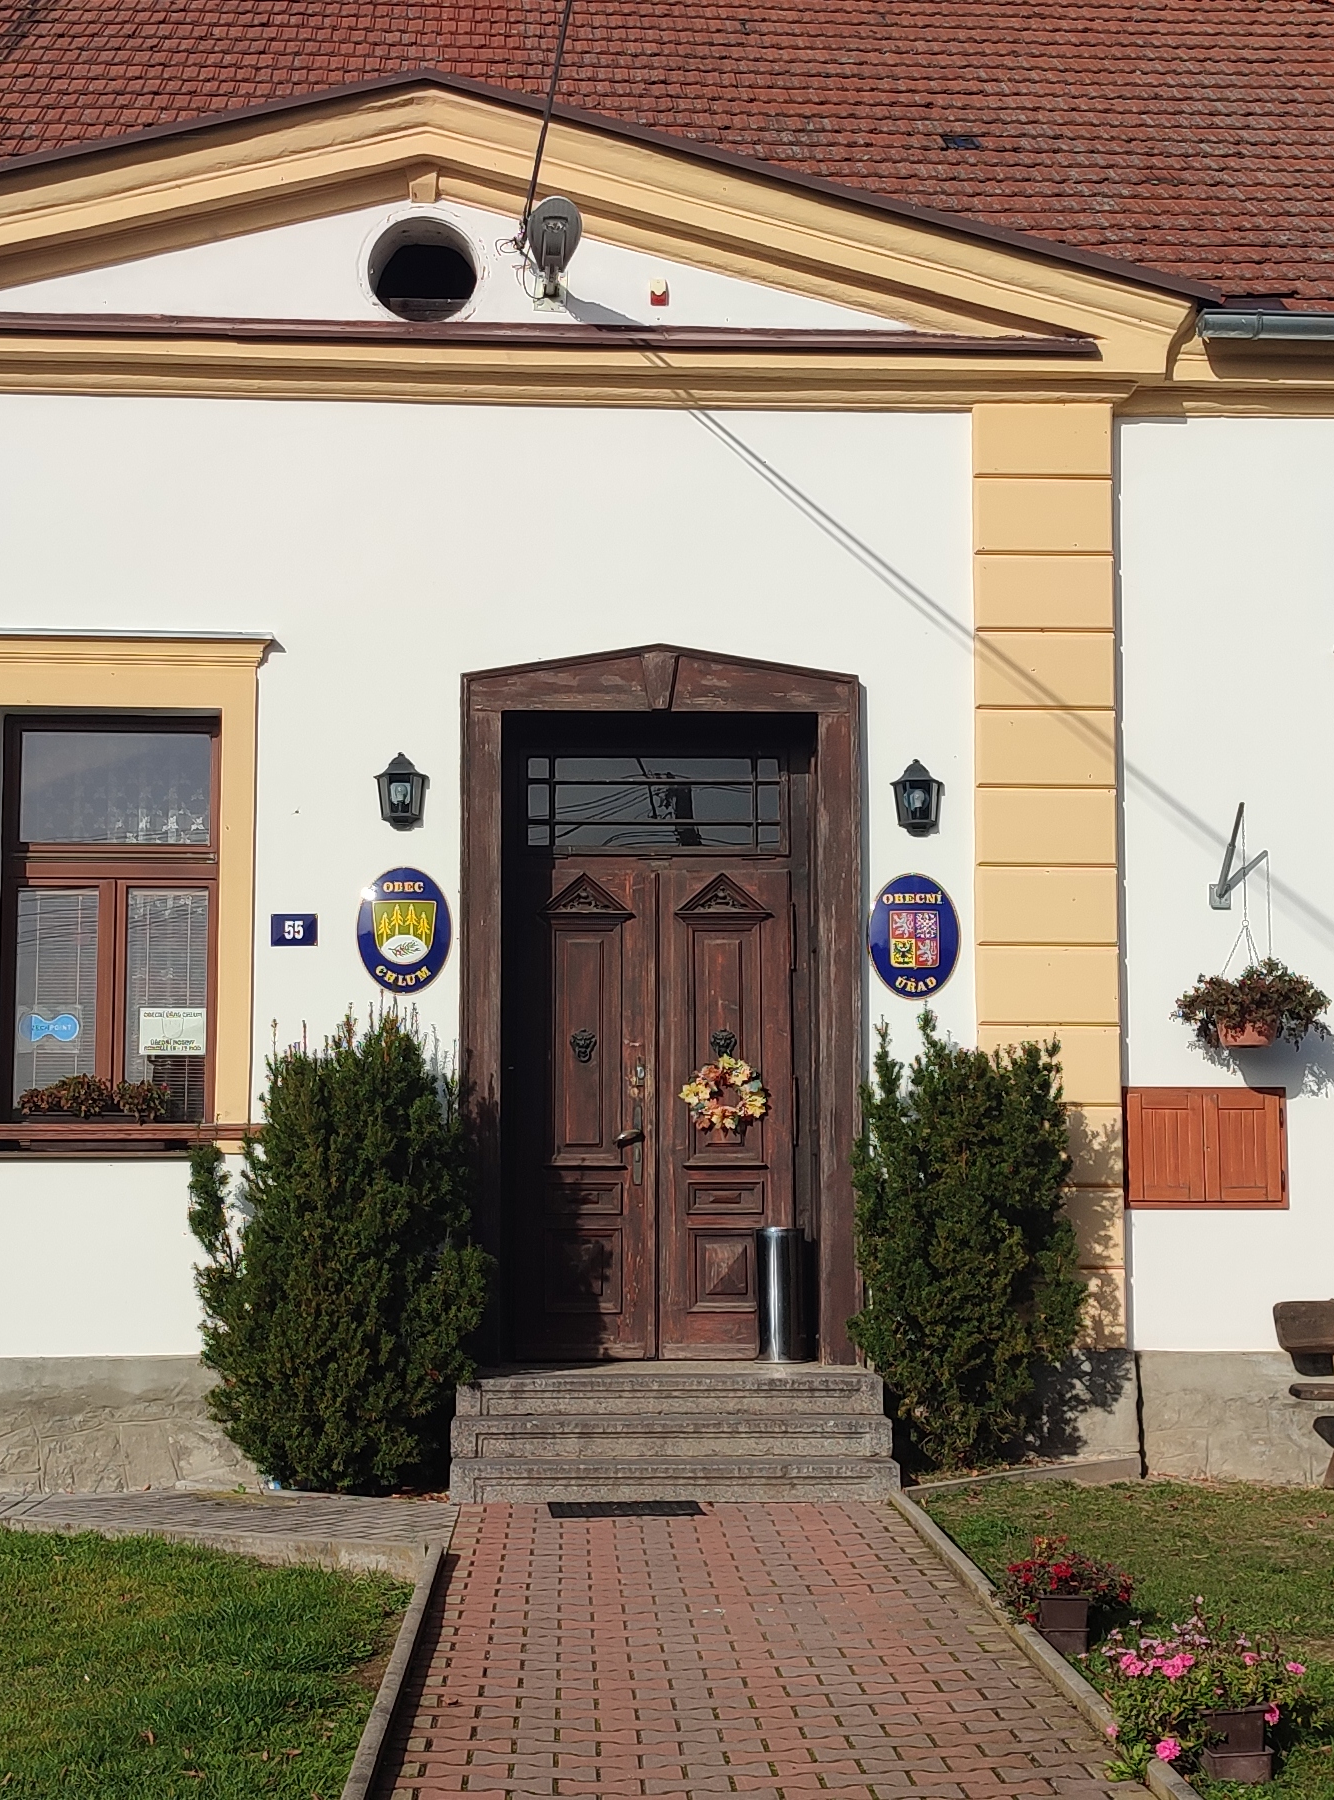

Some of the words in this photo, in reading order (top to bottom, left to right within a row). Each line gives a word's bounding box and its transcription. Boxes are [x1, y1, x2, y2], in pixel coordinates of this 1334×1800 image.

[382, 881, 425, 893] OBEC
[882, 890, 944, 905] OBECNÍ
[283, 920, 304, 940] 55
[375, 965, 432, 987] CHLUM
[895, 975, 937, 993] ÚŘAD
